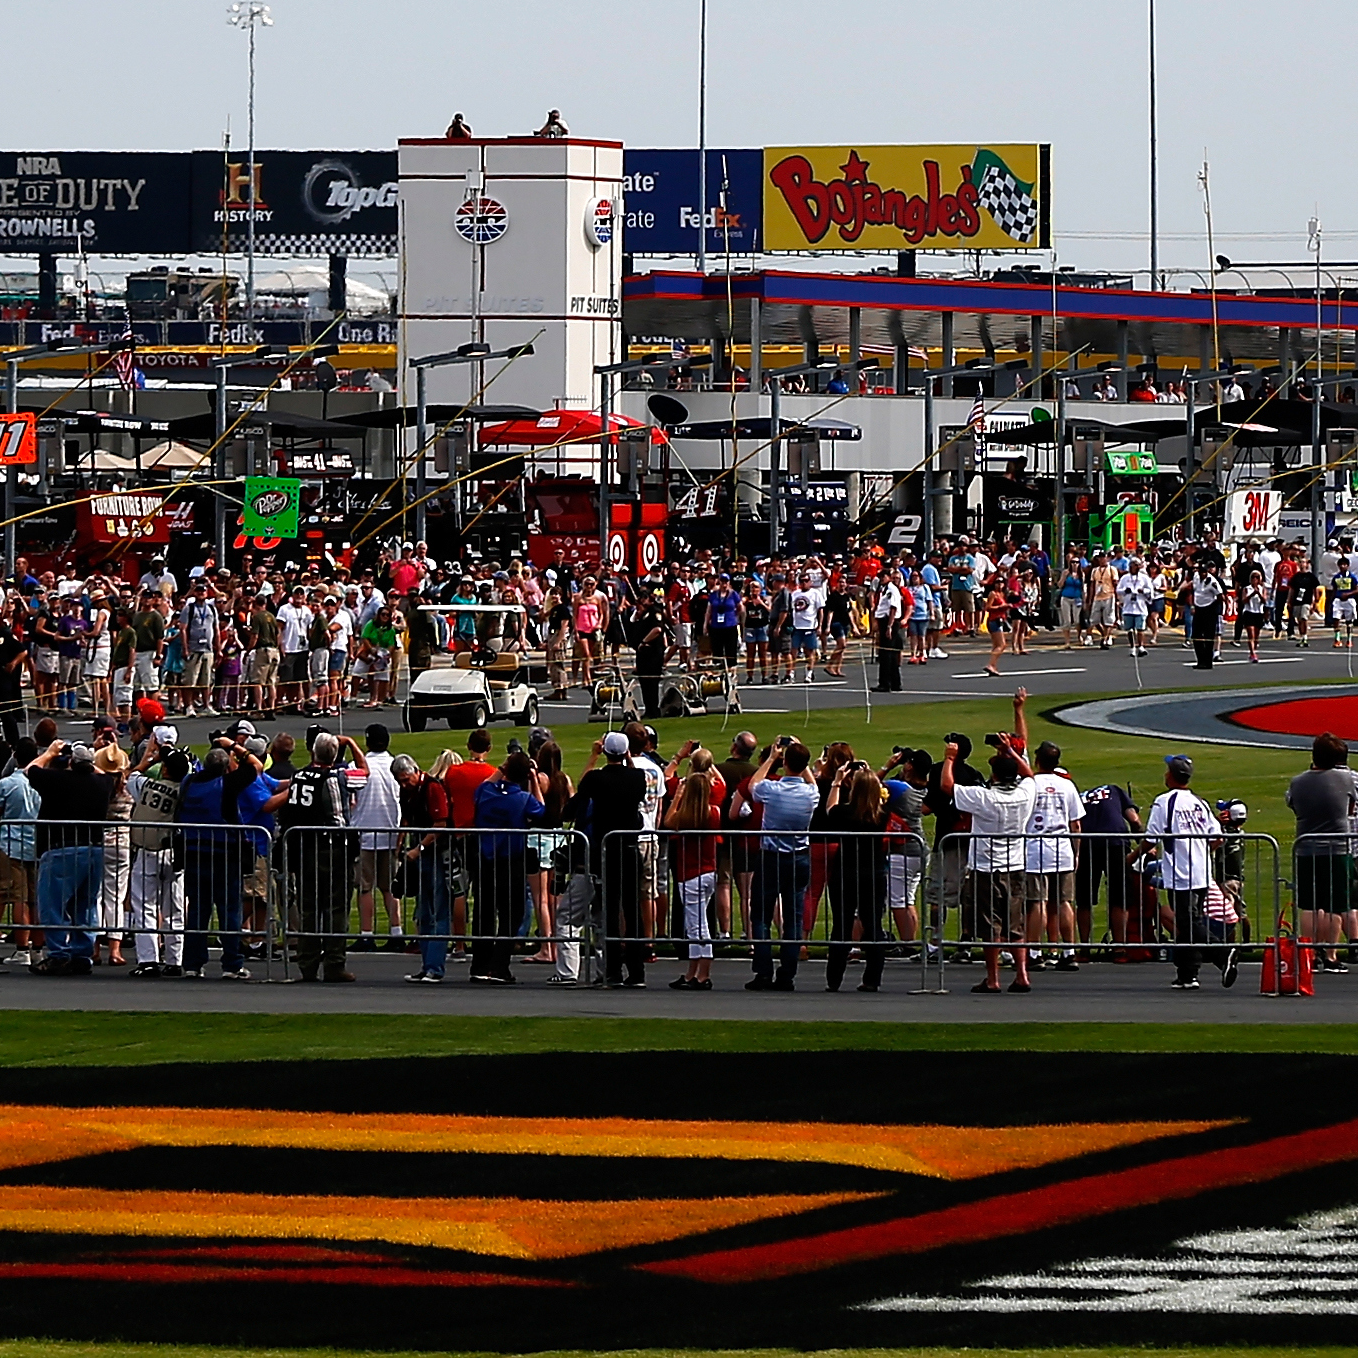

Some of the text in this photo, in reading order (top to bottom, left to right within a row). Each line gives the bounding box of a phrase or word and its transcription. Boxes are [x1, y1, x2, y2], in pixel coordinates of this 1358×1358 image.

[16, 157, 62, 176] NRA
[623, 170, 654, 192] ate
[25, 185, 50, 201] OF
[55, 178, 146, 211] DUTY
[326, 180, 399, 213] TopG
[769, 150, 980, 244] Bojangles'
[214, 211, 274, 222] HISTORY
[680, 207, 741, 229] FedEx
[423, 296, 545, 313] PIT SUITES
[570, 297, 619, 315] PIT SUITES
[209, 323, 264, 343] FedEx
[338, 324, 374, 343] One
[135, 355, 199, 368] TOYOTA
[313, 452, 327, 471] 41
[90, 495, 164, 517] FURNITURE ROW
[256, 495, 287, 515] Pepper
[675, 485, 721, 519] 41
[1242, 492, 1270, 532] 3M
[887, 514, 922, 544] 2
[444, 560, 463, 575] 33
[145, 780, 178, 797] MEDIA
[289, 783, 315, 807] 15
[143, 790, 172, 814] 138
